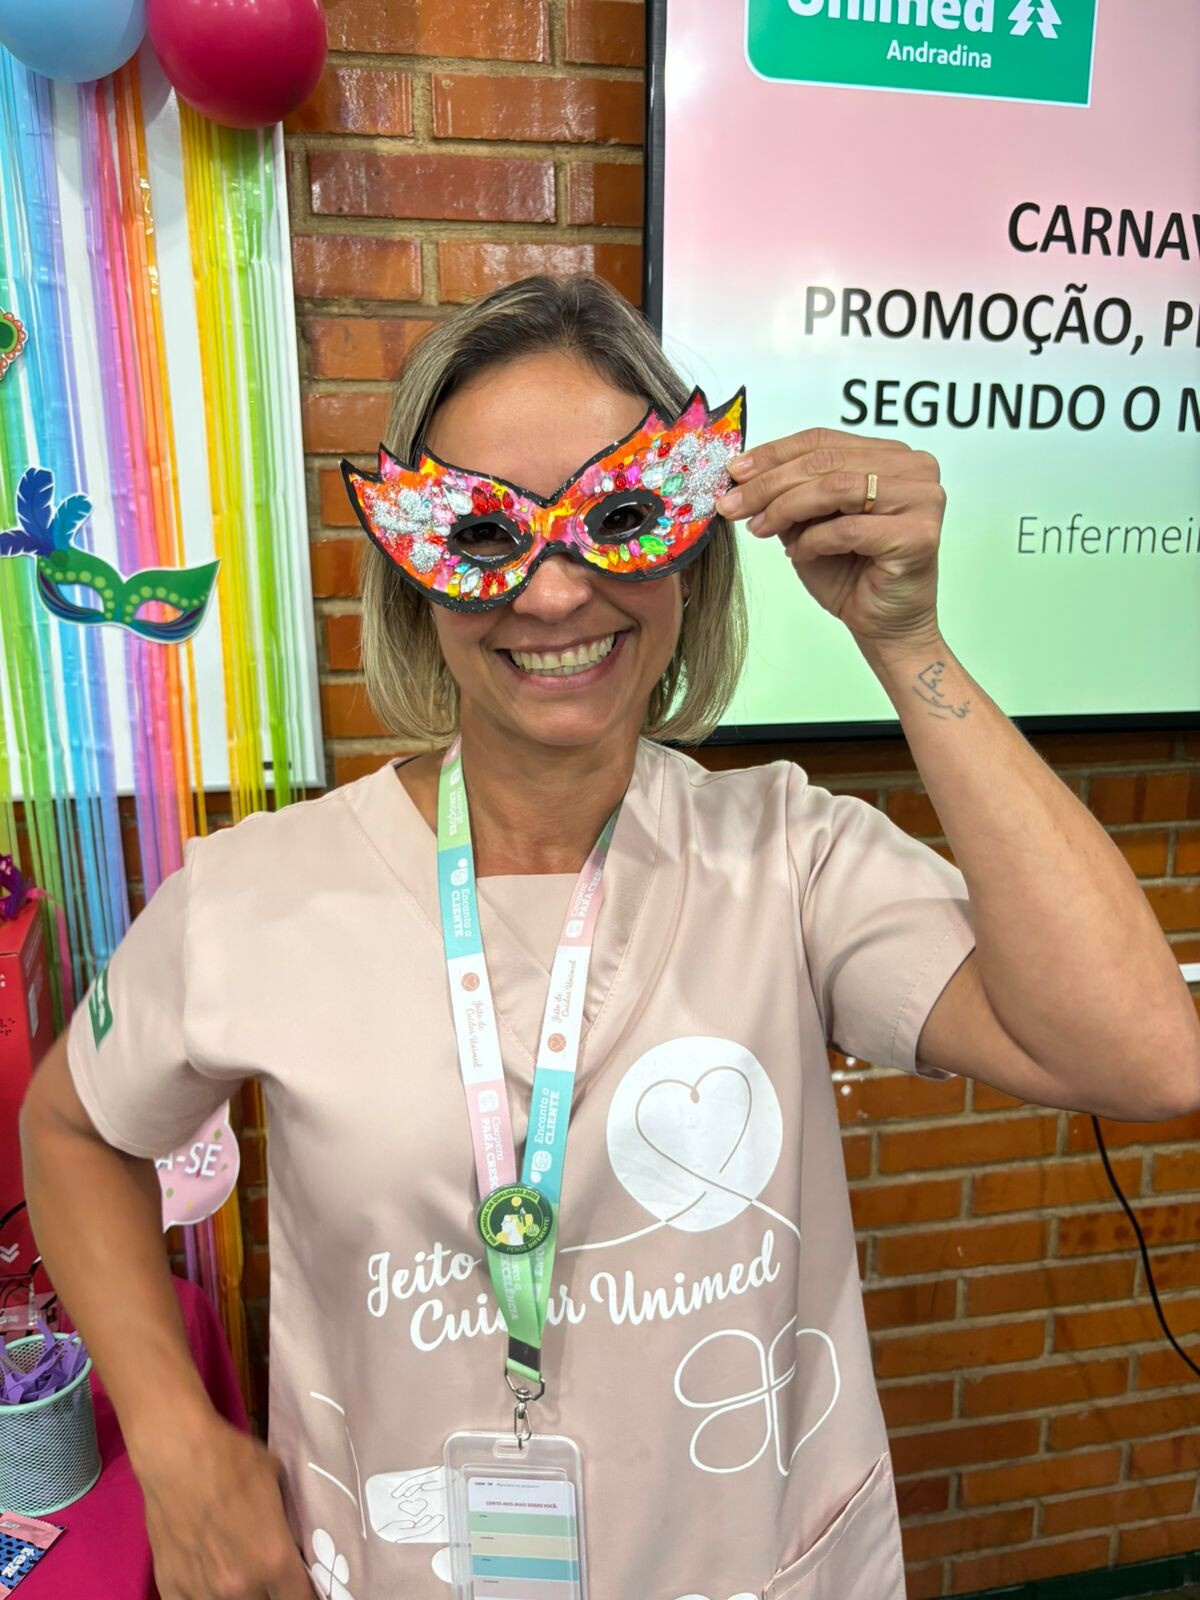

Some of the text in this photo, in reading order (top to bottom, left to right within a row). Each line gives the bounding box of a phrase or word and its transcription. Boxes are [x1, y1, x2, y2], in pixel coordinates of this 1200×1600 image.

[886, 39, 992, 69] Andradina
[1007, 201, 1200, 261] CARNA
[804, 284, 1144, 356] PROMOÇÃO,
[840, 378, 1106, 432] SEGUNDO
[1123, 385, 1161, 432] O
[451, 890, 464, 938] CLIENTE
[534, 1097, 549, 1144] Encanta
[545, 1091, 560, 1145] CLIENTE
[493, 1189, 524, 1204] QUALIDADE
[367, 1241, 482, 1318] Jeito
[590, 1229, 781, 1326] Unimed
